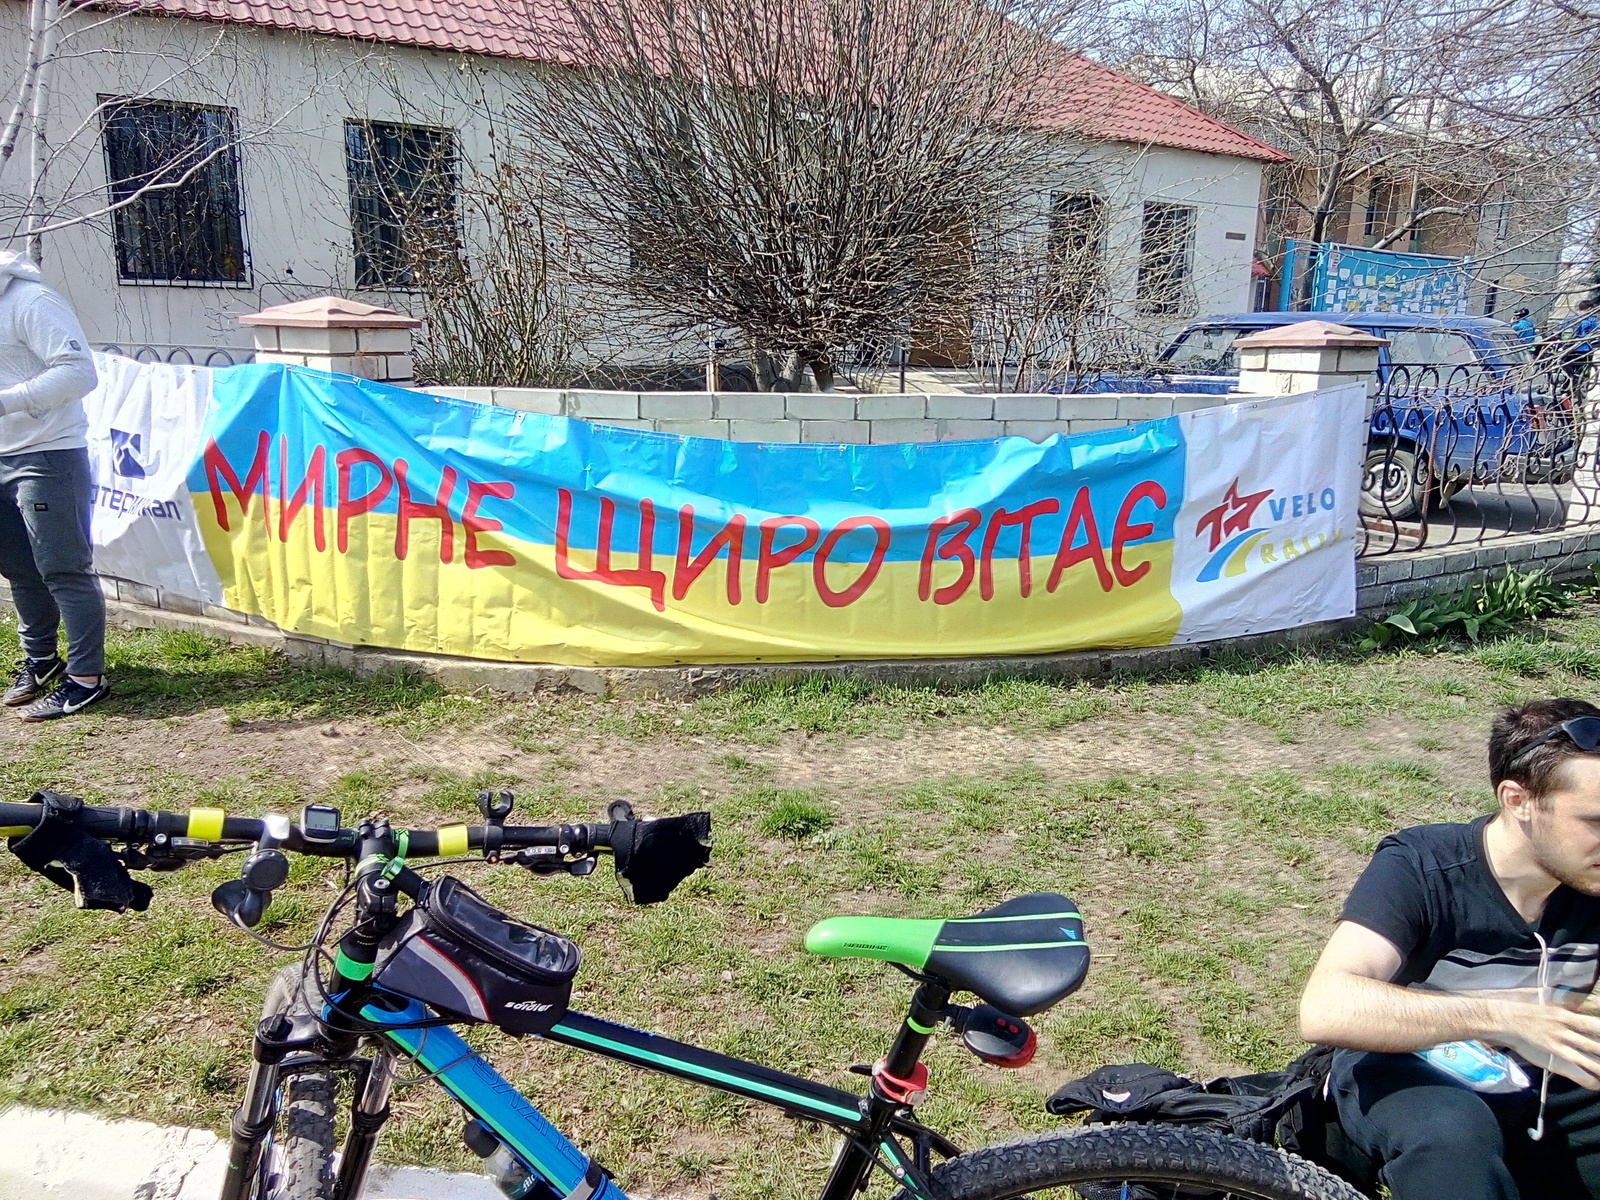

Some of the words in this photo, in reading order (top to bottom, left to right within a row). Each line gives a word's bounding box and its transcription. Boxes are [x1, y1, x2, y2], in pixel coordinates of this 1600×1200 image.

[204, 429, 517, 569] МИРНЕ
[556, 488, 891, 612] ЩИРО
[918, 480, 1167, 606] ВІТАЄ
[1268, 487, 1336, 521] VELO
